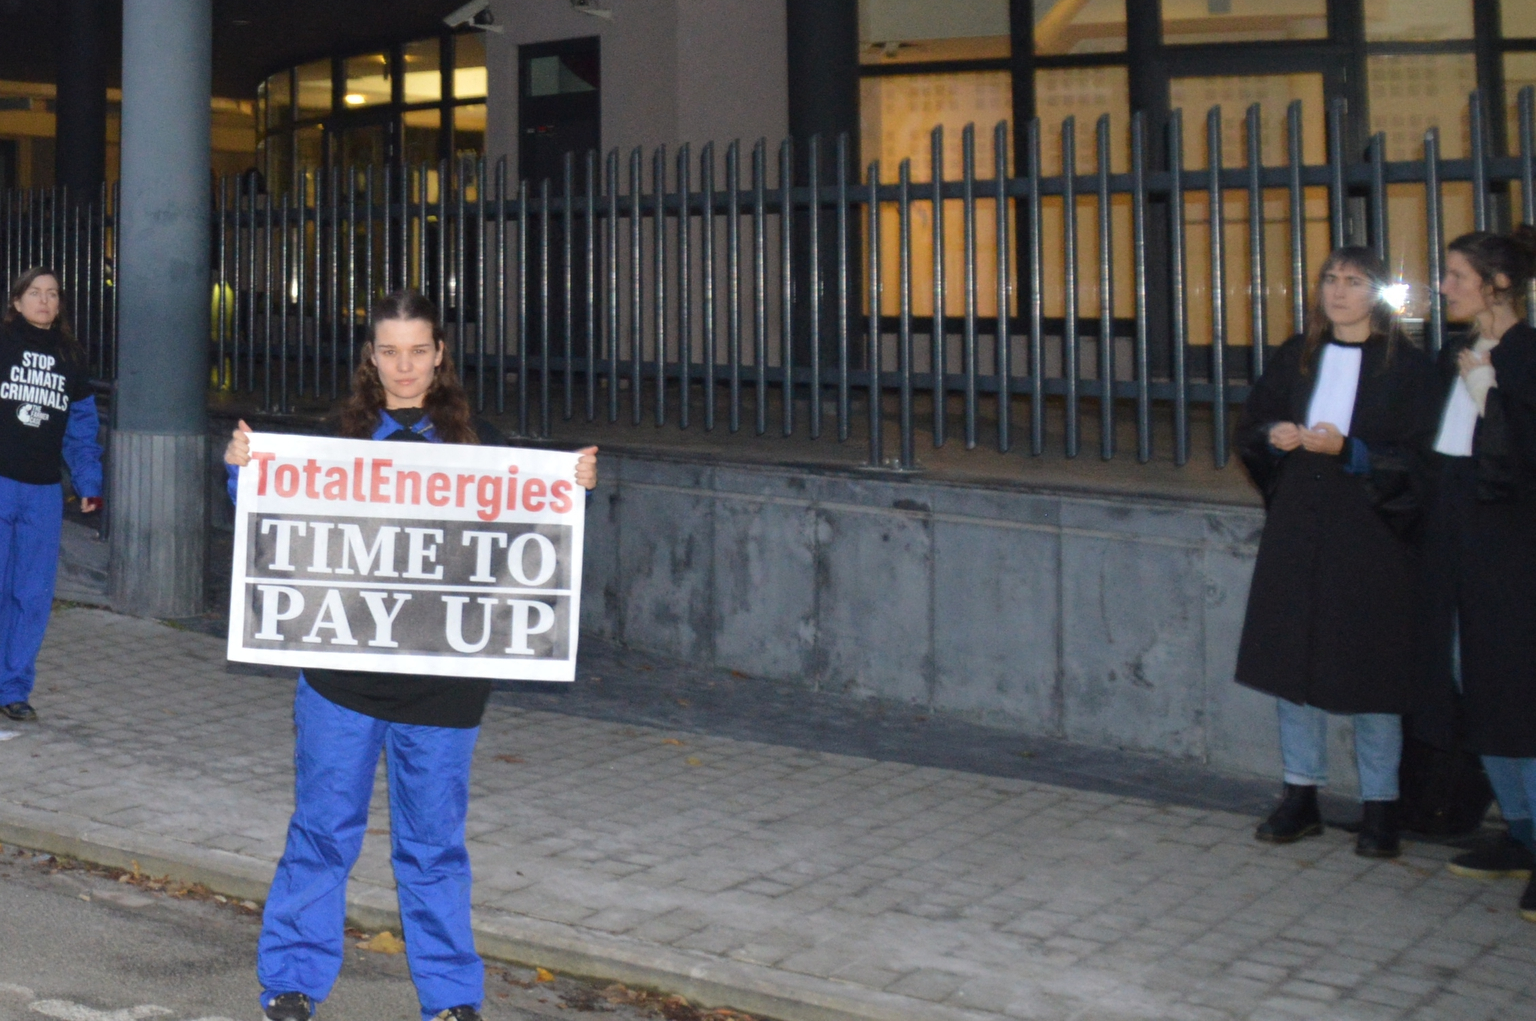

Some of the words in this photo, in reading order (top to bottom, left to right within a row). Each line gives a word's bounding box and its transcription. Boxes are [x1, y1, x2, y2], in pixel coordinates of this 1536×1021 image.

[10, 366, 66, 393] CLIMATE
[22, 350, 56, 371] STOP
[0, 382, 69, 412] CRIMINALS
[251, 451, 573, 522] TotalEnergies
[261, 519, 444, 580] TIME
[462, 531, 557, 587] TO
[254, 584, 412, 648] PAY
[441, 595, 555, 655] UP
